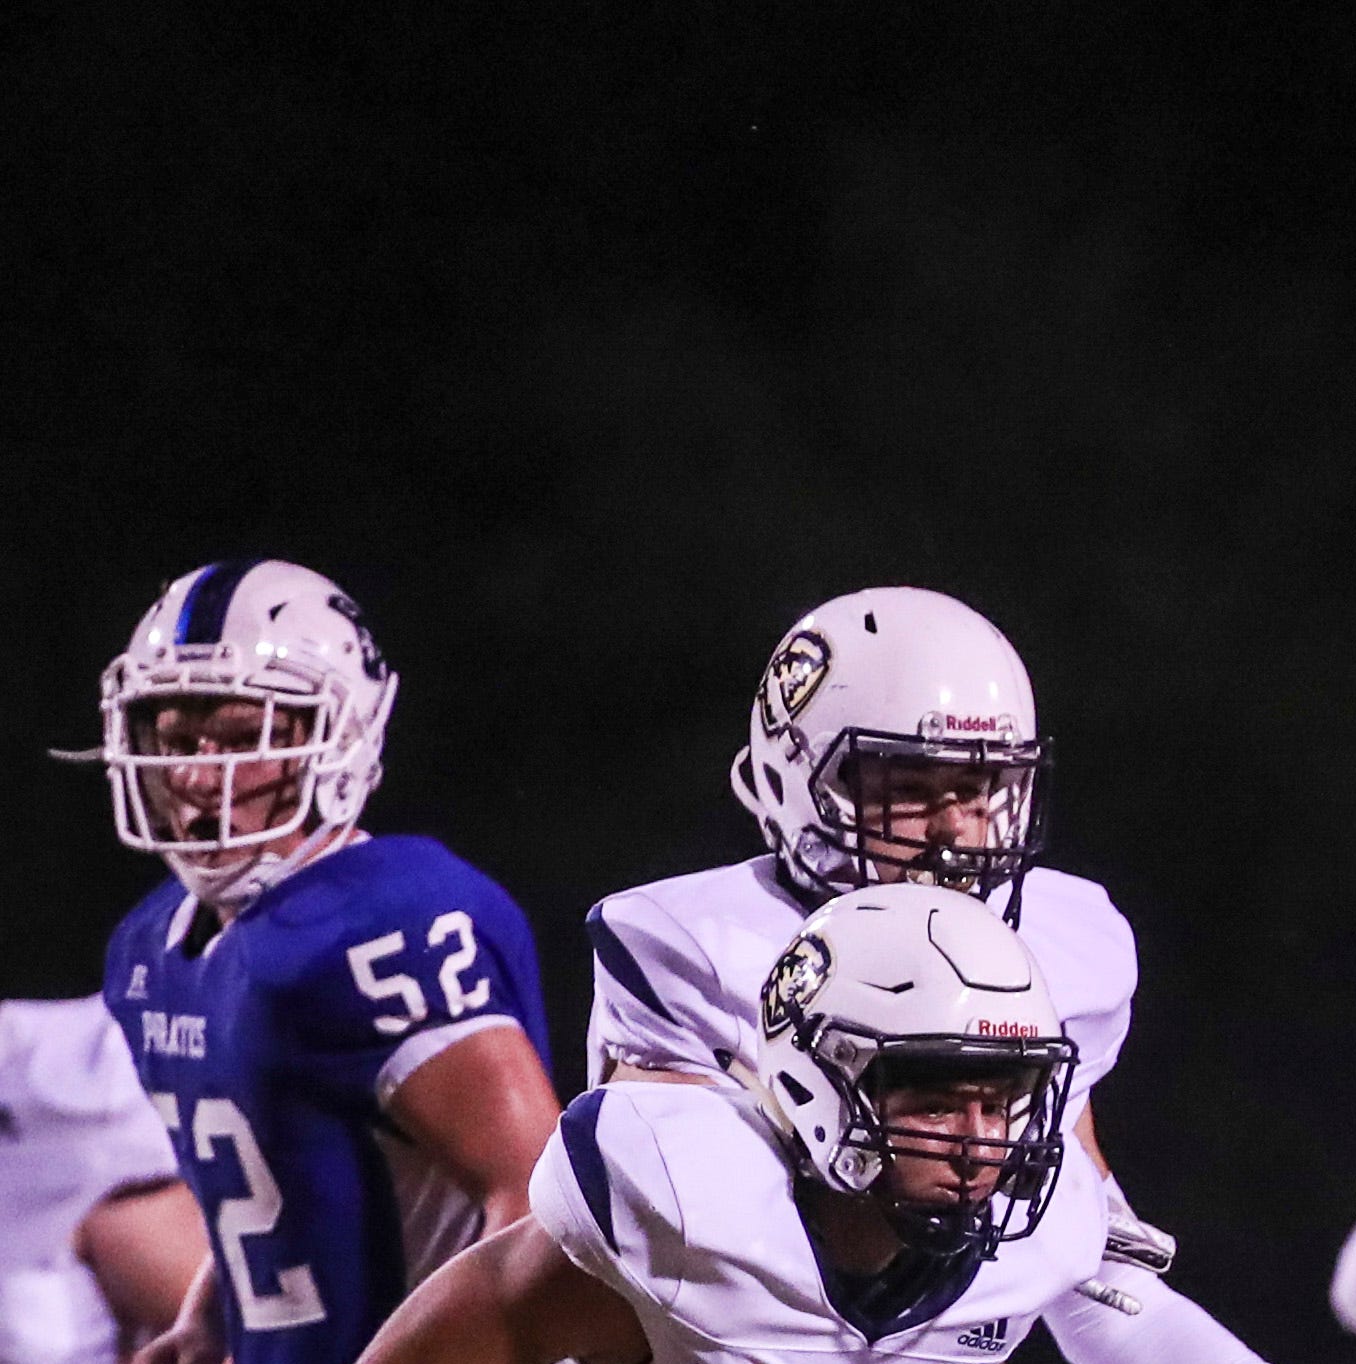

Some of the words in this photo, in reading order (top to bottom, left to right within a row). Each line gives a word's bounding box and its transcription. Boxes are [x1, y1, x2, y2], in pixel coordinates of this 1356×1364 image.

[945, 714, 997, 732] Riddell
[346, 910, 491, 1035] 52
[978, 1018, 1039, 1039] Riddell
[150, 1091, 329, 1332] 2
